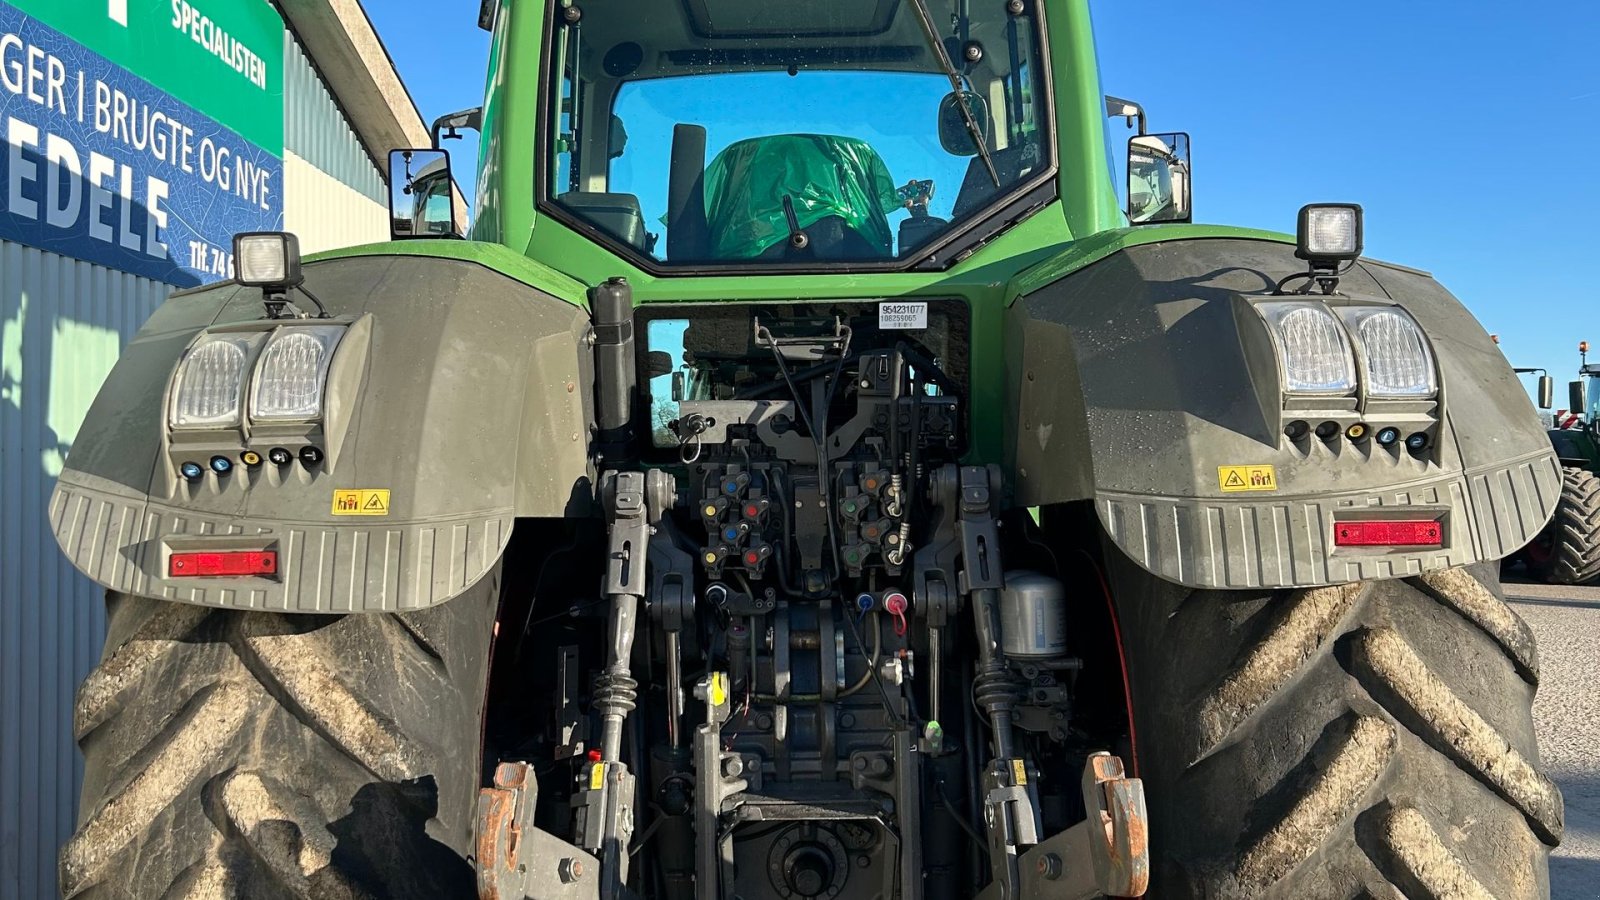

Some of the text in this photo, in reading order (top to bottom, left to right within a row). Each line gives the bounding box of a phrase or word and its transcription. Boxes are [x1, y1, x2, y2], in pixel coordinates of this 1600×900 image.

[172, 0, 266, 91] SPECIALISTEN
[0, 33, 269, 211] GER I BRUGTE OG NYE
[8, 116, 169, 260] EDELE
[212, 248, 226, 277] 74
[882, 305, 924, 314] 954231077
